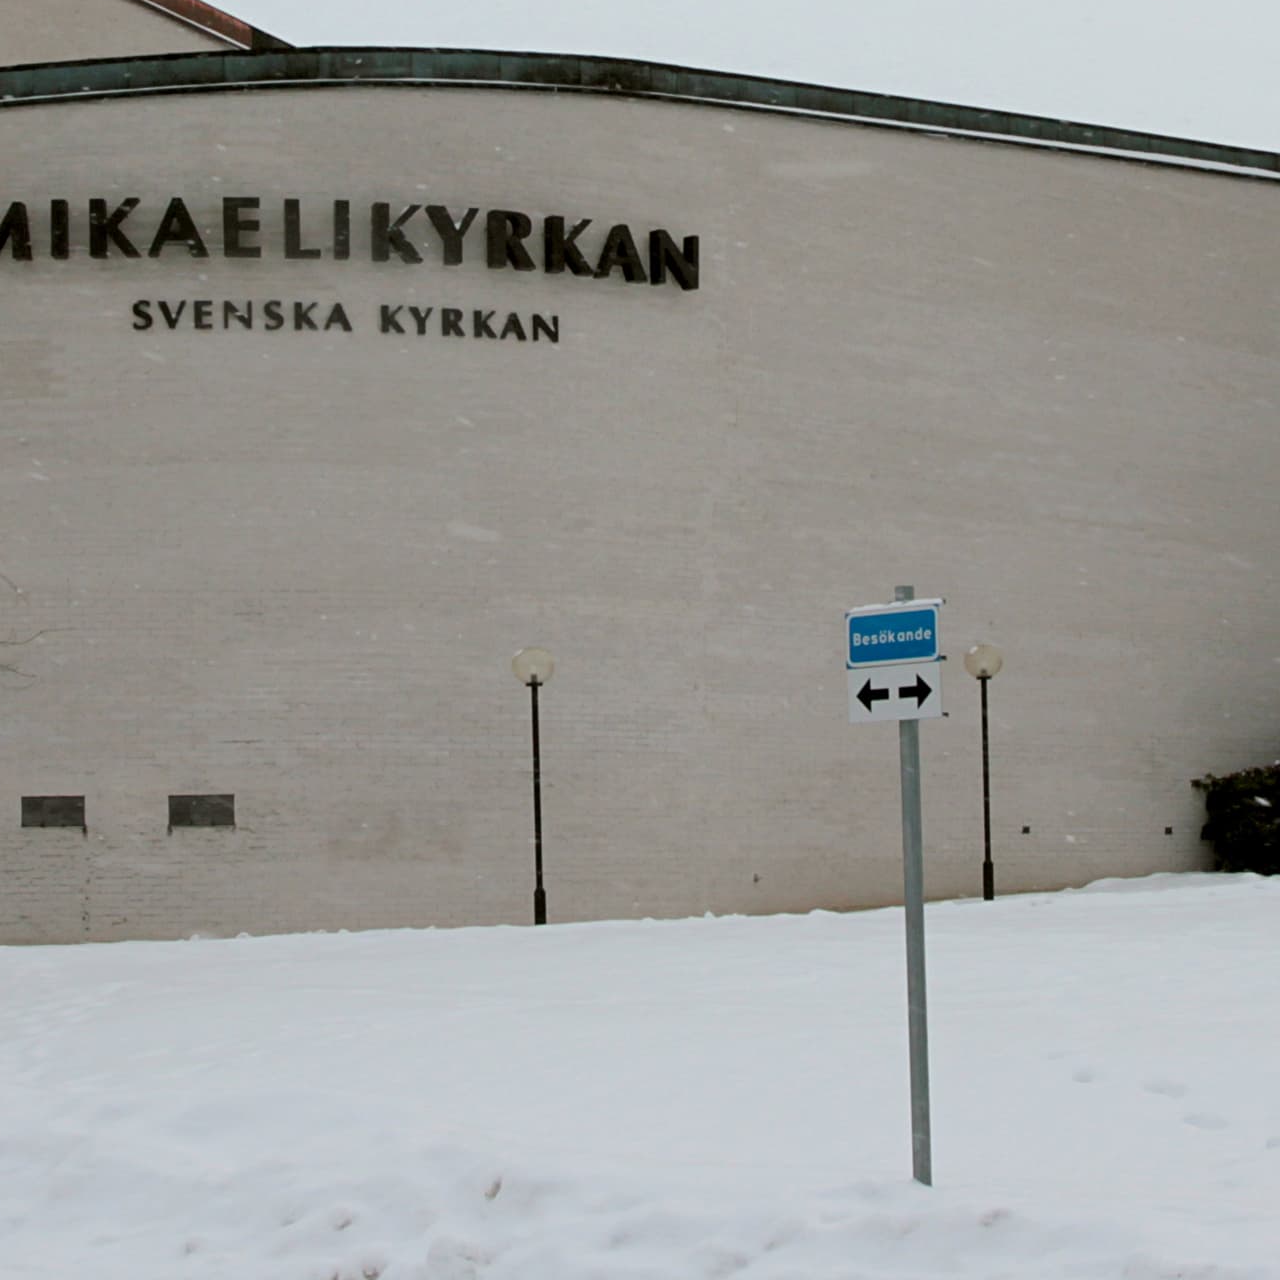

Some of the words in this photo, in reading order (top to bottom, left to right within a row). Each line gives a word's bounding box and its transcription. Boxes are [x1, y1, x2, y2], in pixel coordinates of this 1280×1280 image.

[131, 299, 353, 333] SVENSKA
[379, 304, 561, 343] KYRKAN
[852, 627, 932, 647] Besökande
